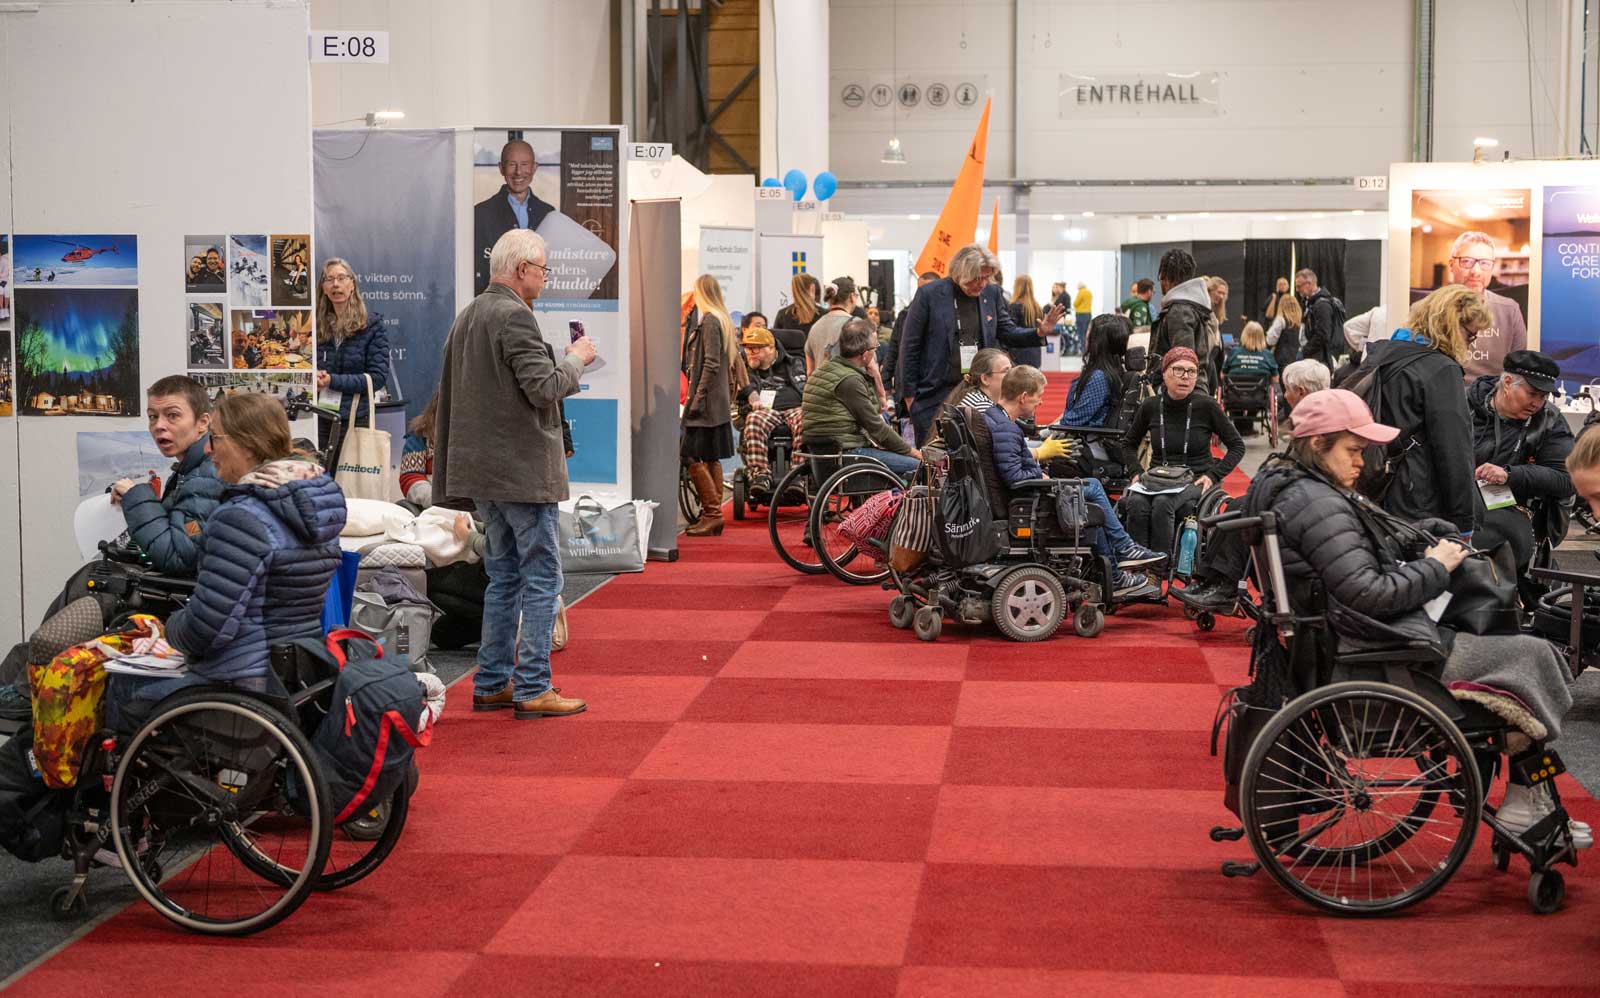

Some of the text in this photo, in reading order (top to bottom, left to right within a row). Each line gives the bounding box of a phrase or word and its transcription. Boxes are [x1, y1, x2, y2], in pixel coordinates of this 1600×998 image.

[323, 36, 376, 57] E:08
[1077, 79, 1200, 104] ENTRÉHALL
[635, 145, 665, 158] E:07
[548, 246, 609, 261] mästare
[1561, 255, 1600, 267] CARE
[549, 263, 587, 277] rdens
[1571, 267, 1600, 279] FOR
[364, 272, 397, 284] vikten
[399, 274, 414, 284] av
[543, 277, 602, 291] rkudde!
[392, 290, 427, 301] sömn.
